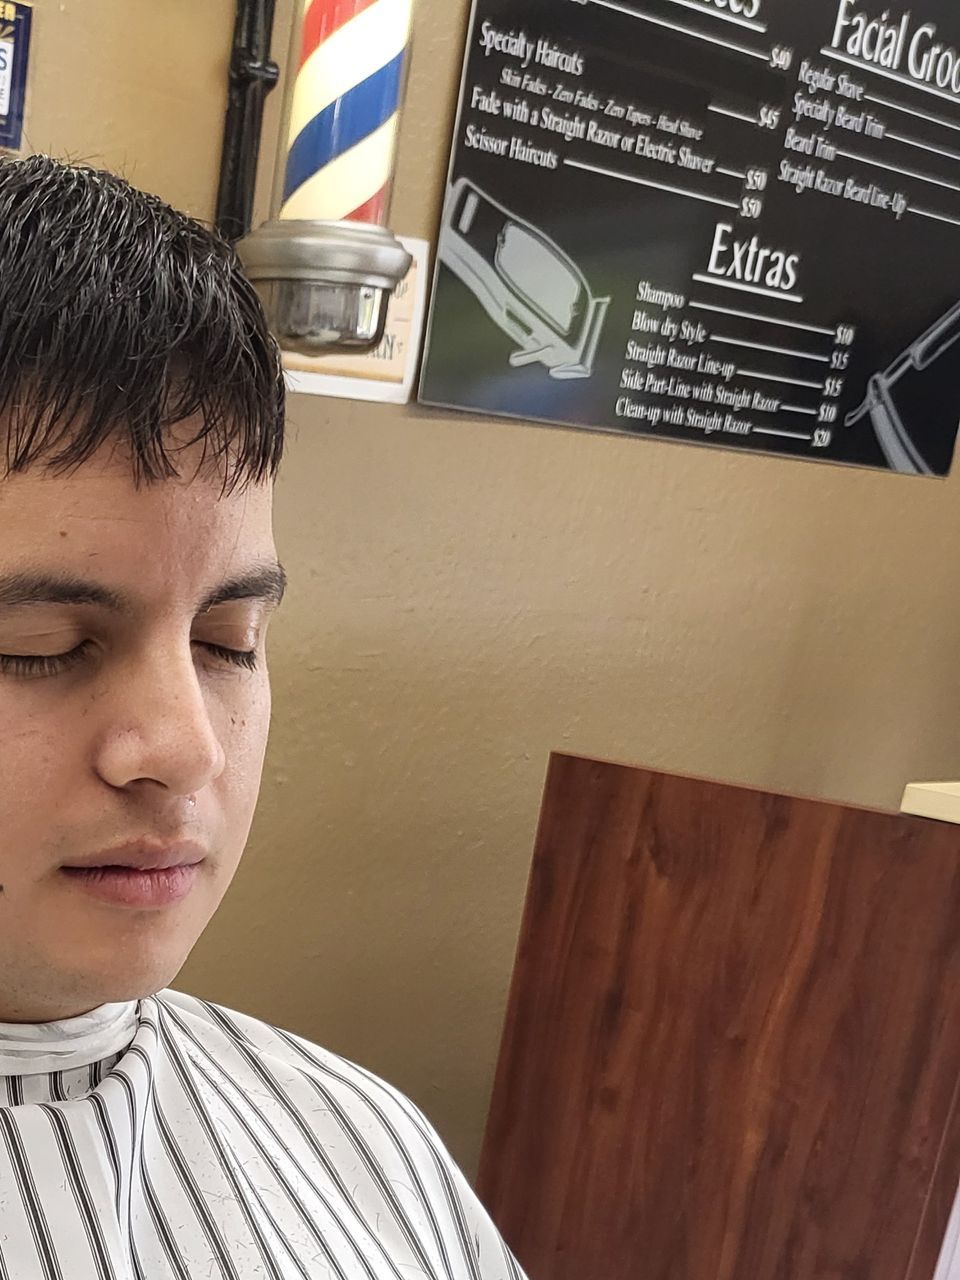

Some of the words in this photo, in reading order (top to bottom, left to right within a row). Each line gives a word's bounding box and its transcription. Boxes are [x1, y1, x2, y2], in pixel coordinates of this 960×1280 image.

[479, 21, 535, 68] Specialty
[535, 40, 584, 75] Haircuts
[831, 0, 909, 69] Facial
[500, 67, 521, 88] Skin
[521, 75, 547, 96] Fades
[574, 90, 599, 111] Fades
[798, 60, 836, 94] Regular
[836, 74, 864, 100] Shave
[471, 86, 501, 115] Fade
[503, 98, 529, 123] with
[530, 109, 539, 126] a
[540, 107, 585, 142] Straight
[586, 120, 621, 149] Razor
[621, 136, 635, 152] or
[635, 134, 676, 164] Electric
[677, 146, 715, 173] Shaver
[792, 92, 835, 130] Specialty
[835, 106, 865, 132] Beard
[865, 115, 885, 139] Trim
[465, 124, 508, 156] Scissor
[509, 137, 558, 169] Haircuts
[784, 127, 816, 155] Beard
[815, 137, 836, 161] Trim
[778, 159, 815, 194] Straight
[815, 170, 844, 196] Razor
[844, 178, 872, 204] Beard
[707, 222, 799, 290] Extras
[636, 281, 684, 309] Shampoo
[834, 324, 854, 345] $10
[632, 310, 660, 333] Blow
[661, 319, 679, 342] dry
[679, 320, 707, 345] Style
[830, 351, 849, 370] $15
[619, 367, 645, 390] Side
[645, 372, 691, 398] Part-Line
[692, 381, 713, 402] with
[715, 386, 751, 411] Straight
[752, 391, 780, 412] Razor
[626, 340, 666, 368] Straight
[666, 347, 697, 370] Razor
[697, 354, 735, 382] Line-up
[822, 377, 843, 397] $15
[615, 396, 662, 427] Clean-up
[663, 403, 685, 424] with
[685, 408, 722, 434] Straight
[722, 413, 752, 434] Razor
